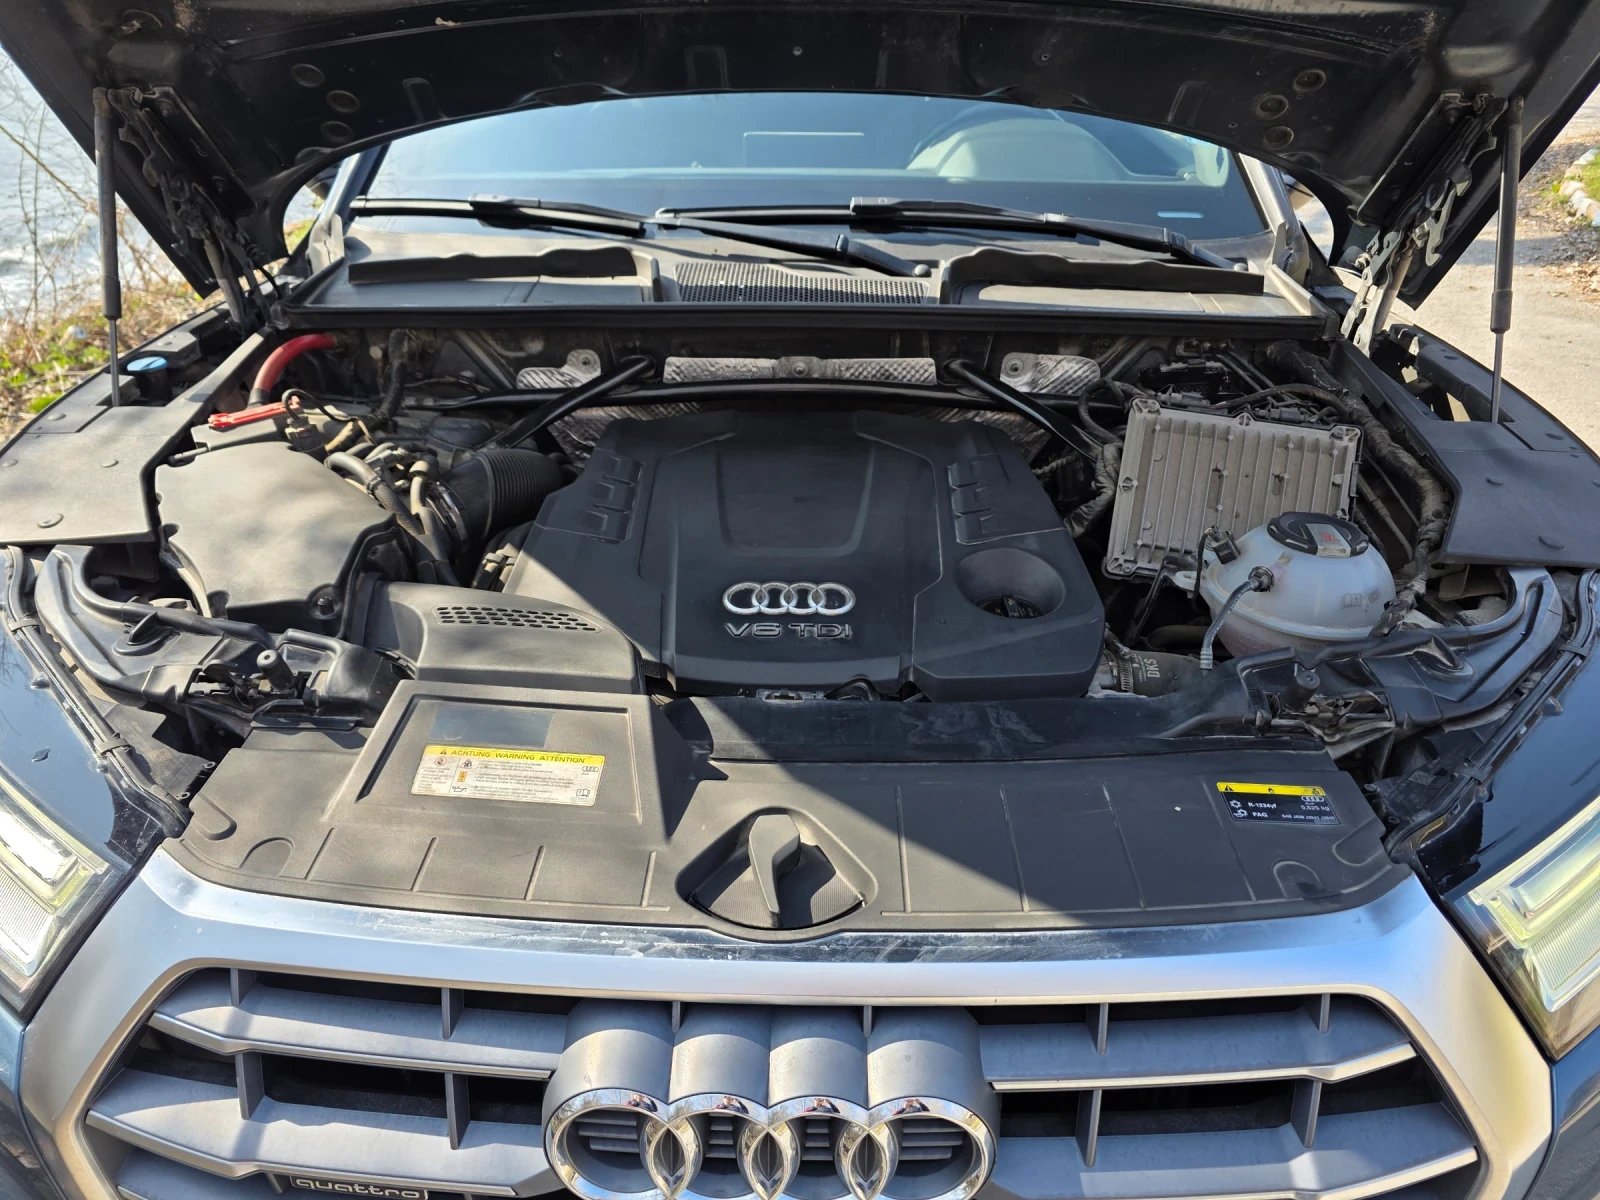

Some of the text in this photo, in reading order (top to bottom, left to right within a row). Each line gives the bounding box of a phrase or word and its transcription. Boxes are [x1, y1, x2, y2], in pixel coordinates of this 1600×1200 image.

[724, 622, 852, 638] V6 TDI
[1144, 658, 1160, 678] DKS
[451, 749, 491, 758] ACHTUNG
[495, 752, 535, 761] WARNING
[540, 754, 586, 764] ATTENTION
[295, 1178, 420, 1199] quattro
